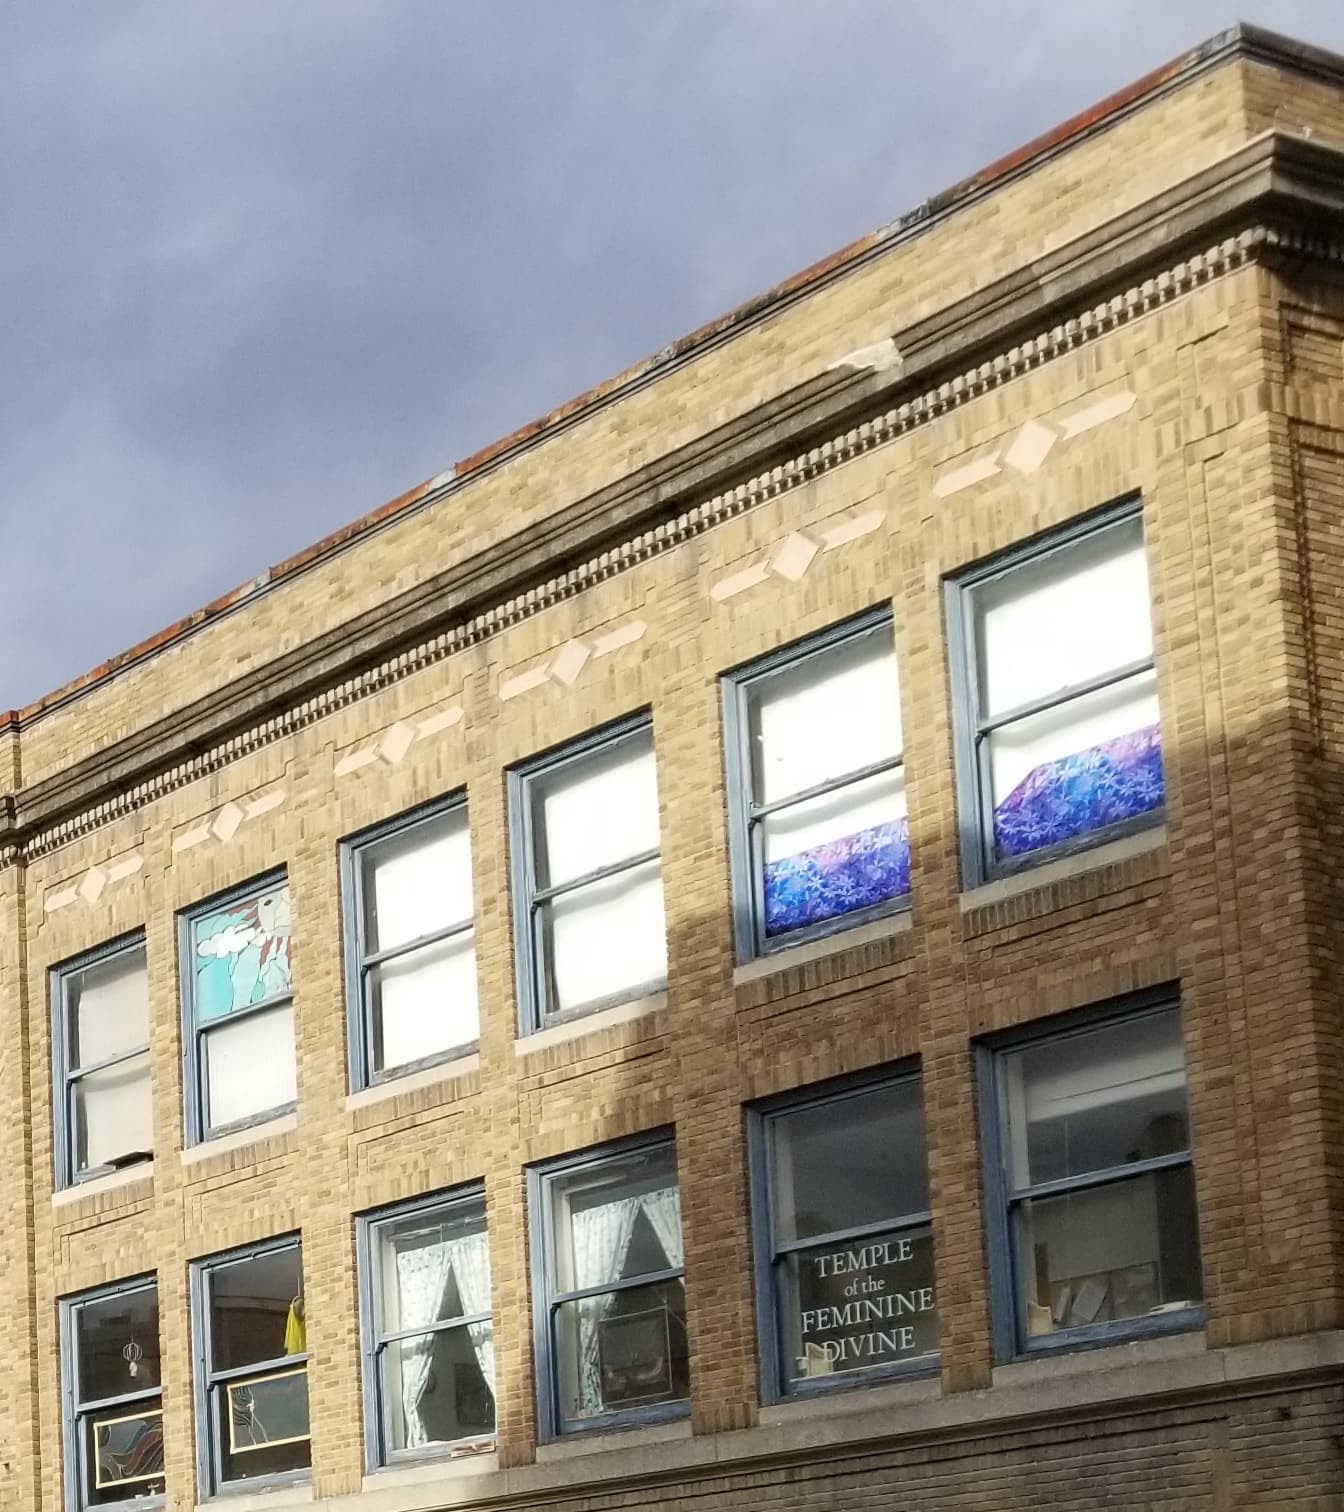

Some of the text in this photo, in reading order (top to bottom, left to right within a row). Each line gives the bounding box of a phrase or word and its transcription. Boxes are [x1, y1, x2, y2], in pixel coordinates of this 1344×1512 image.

[815, 1238, 914, 1279] TEMPLE
[844, 1275, 886, 1297] of the
[801, 1287, 936, 1334] FEMININE
[822, 1326, 916, 1362] DIVINE
